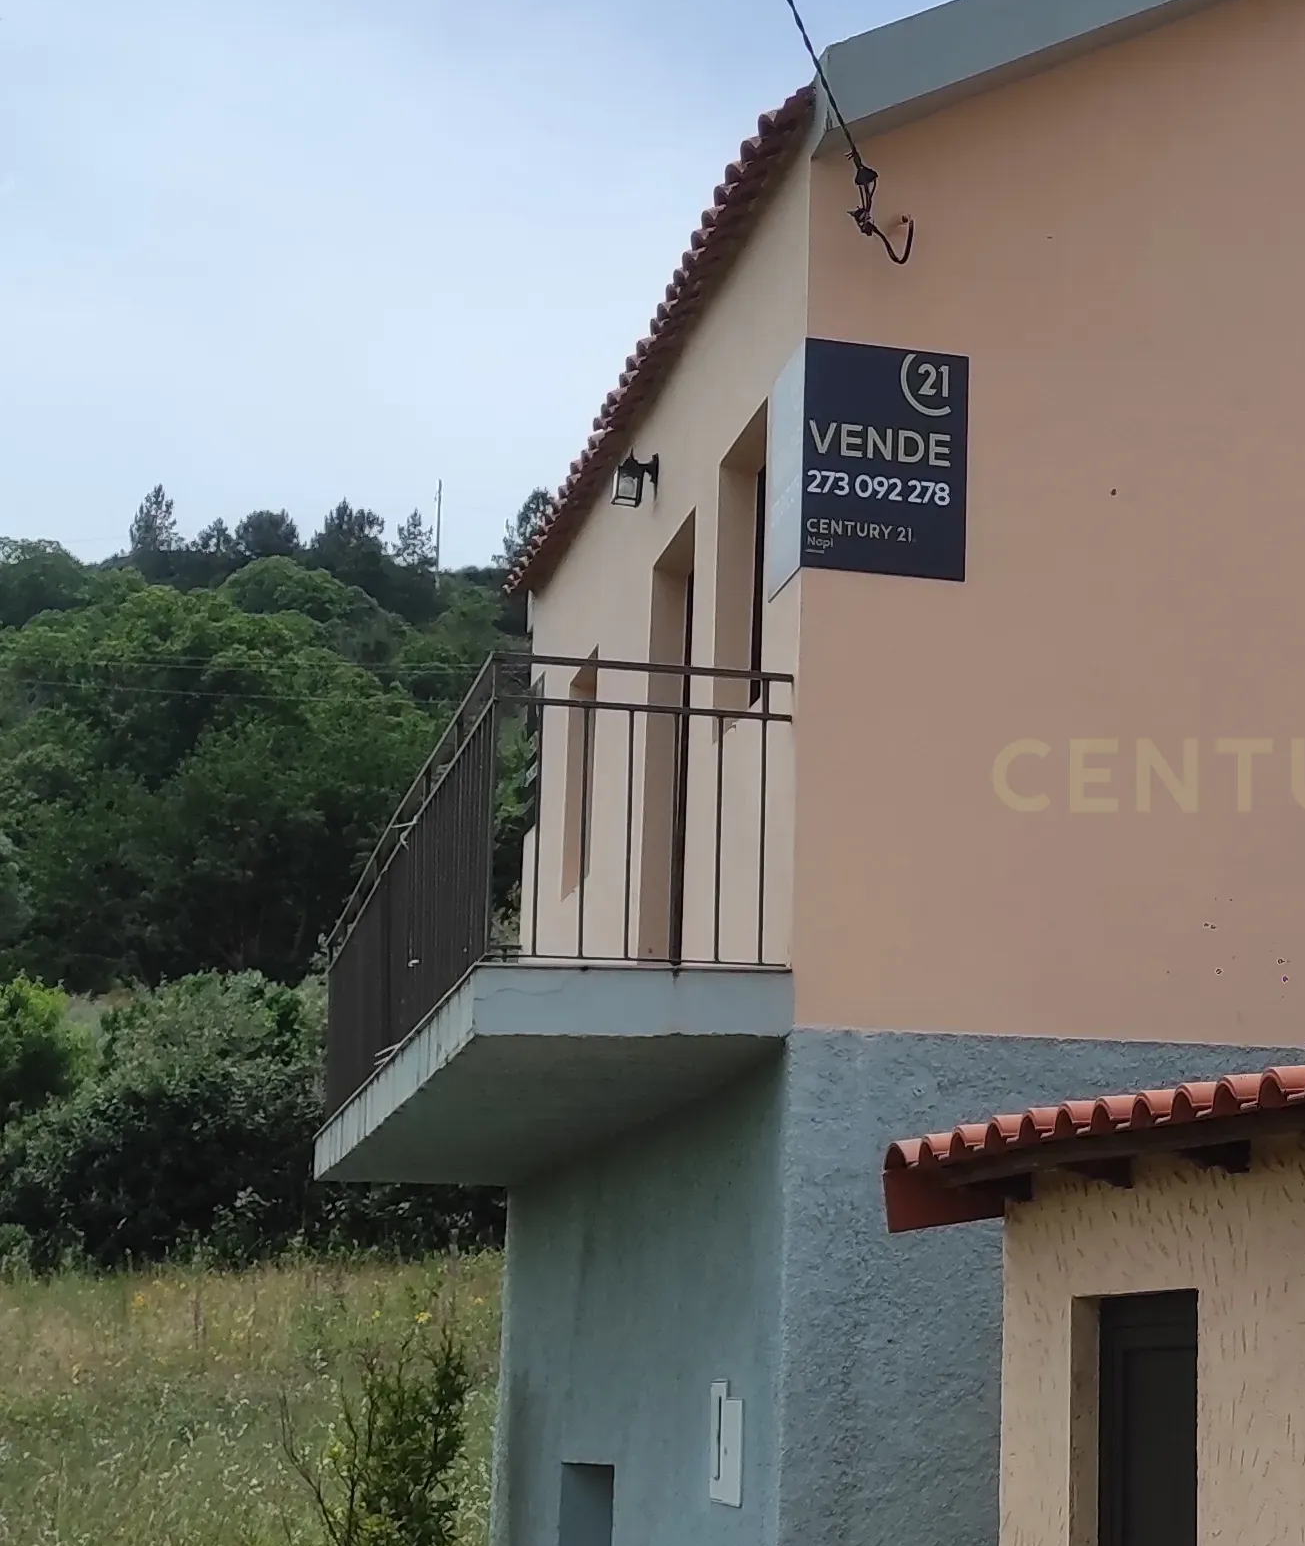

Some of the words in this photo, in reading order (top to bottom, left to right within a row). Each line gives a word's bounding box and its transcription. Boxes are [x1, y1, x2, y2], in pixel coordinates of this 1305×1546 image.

[809, 419, 951, 467] VENDE
[806, 470, 849, 496] 273
[855, 474, 903, 501] 092
[907, 481, 951, 506] 278
[806, 518, 893, 540] CENTURY
[896, 526, 913, 543] 21
